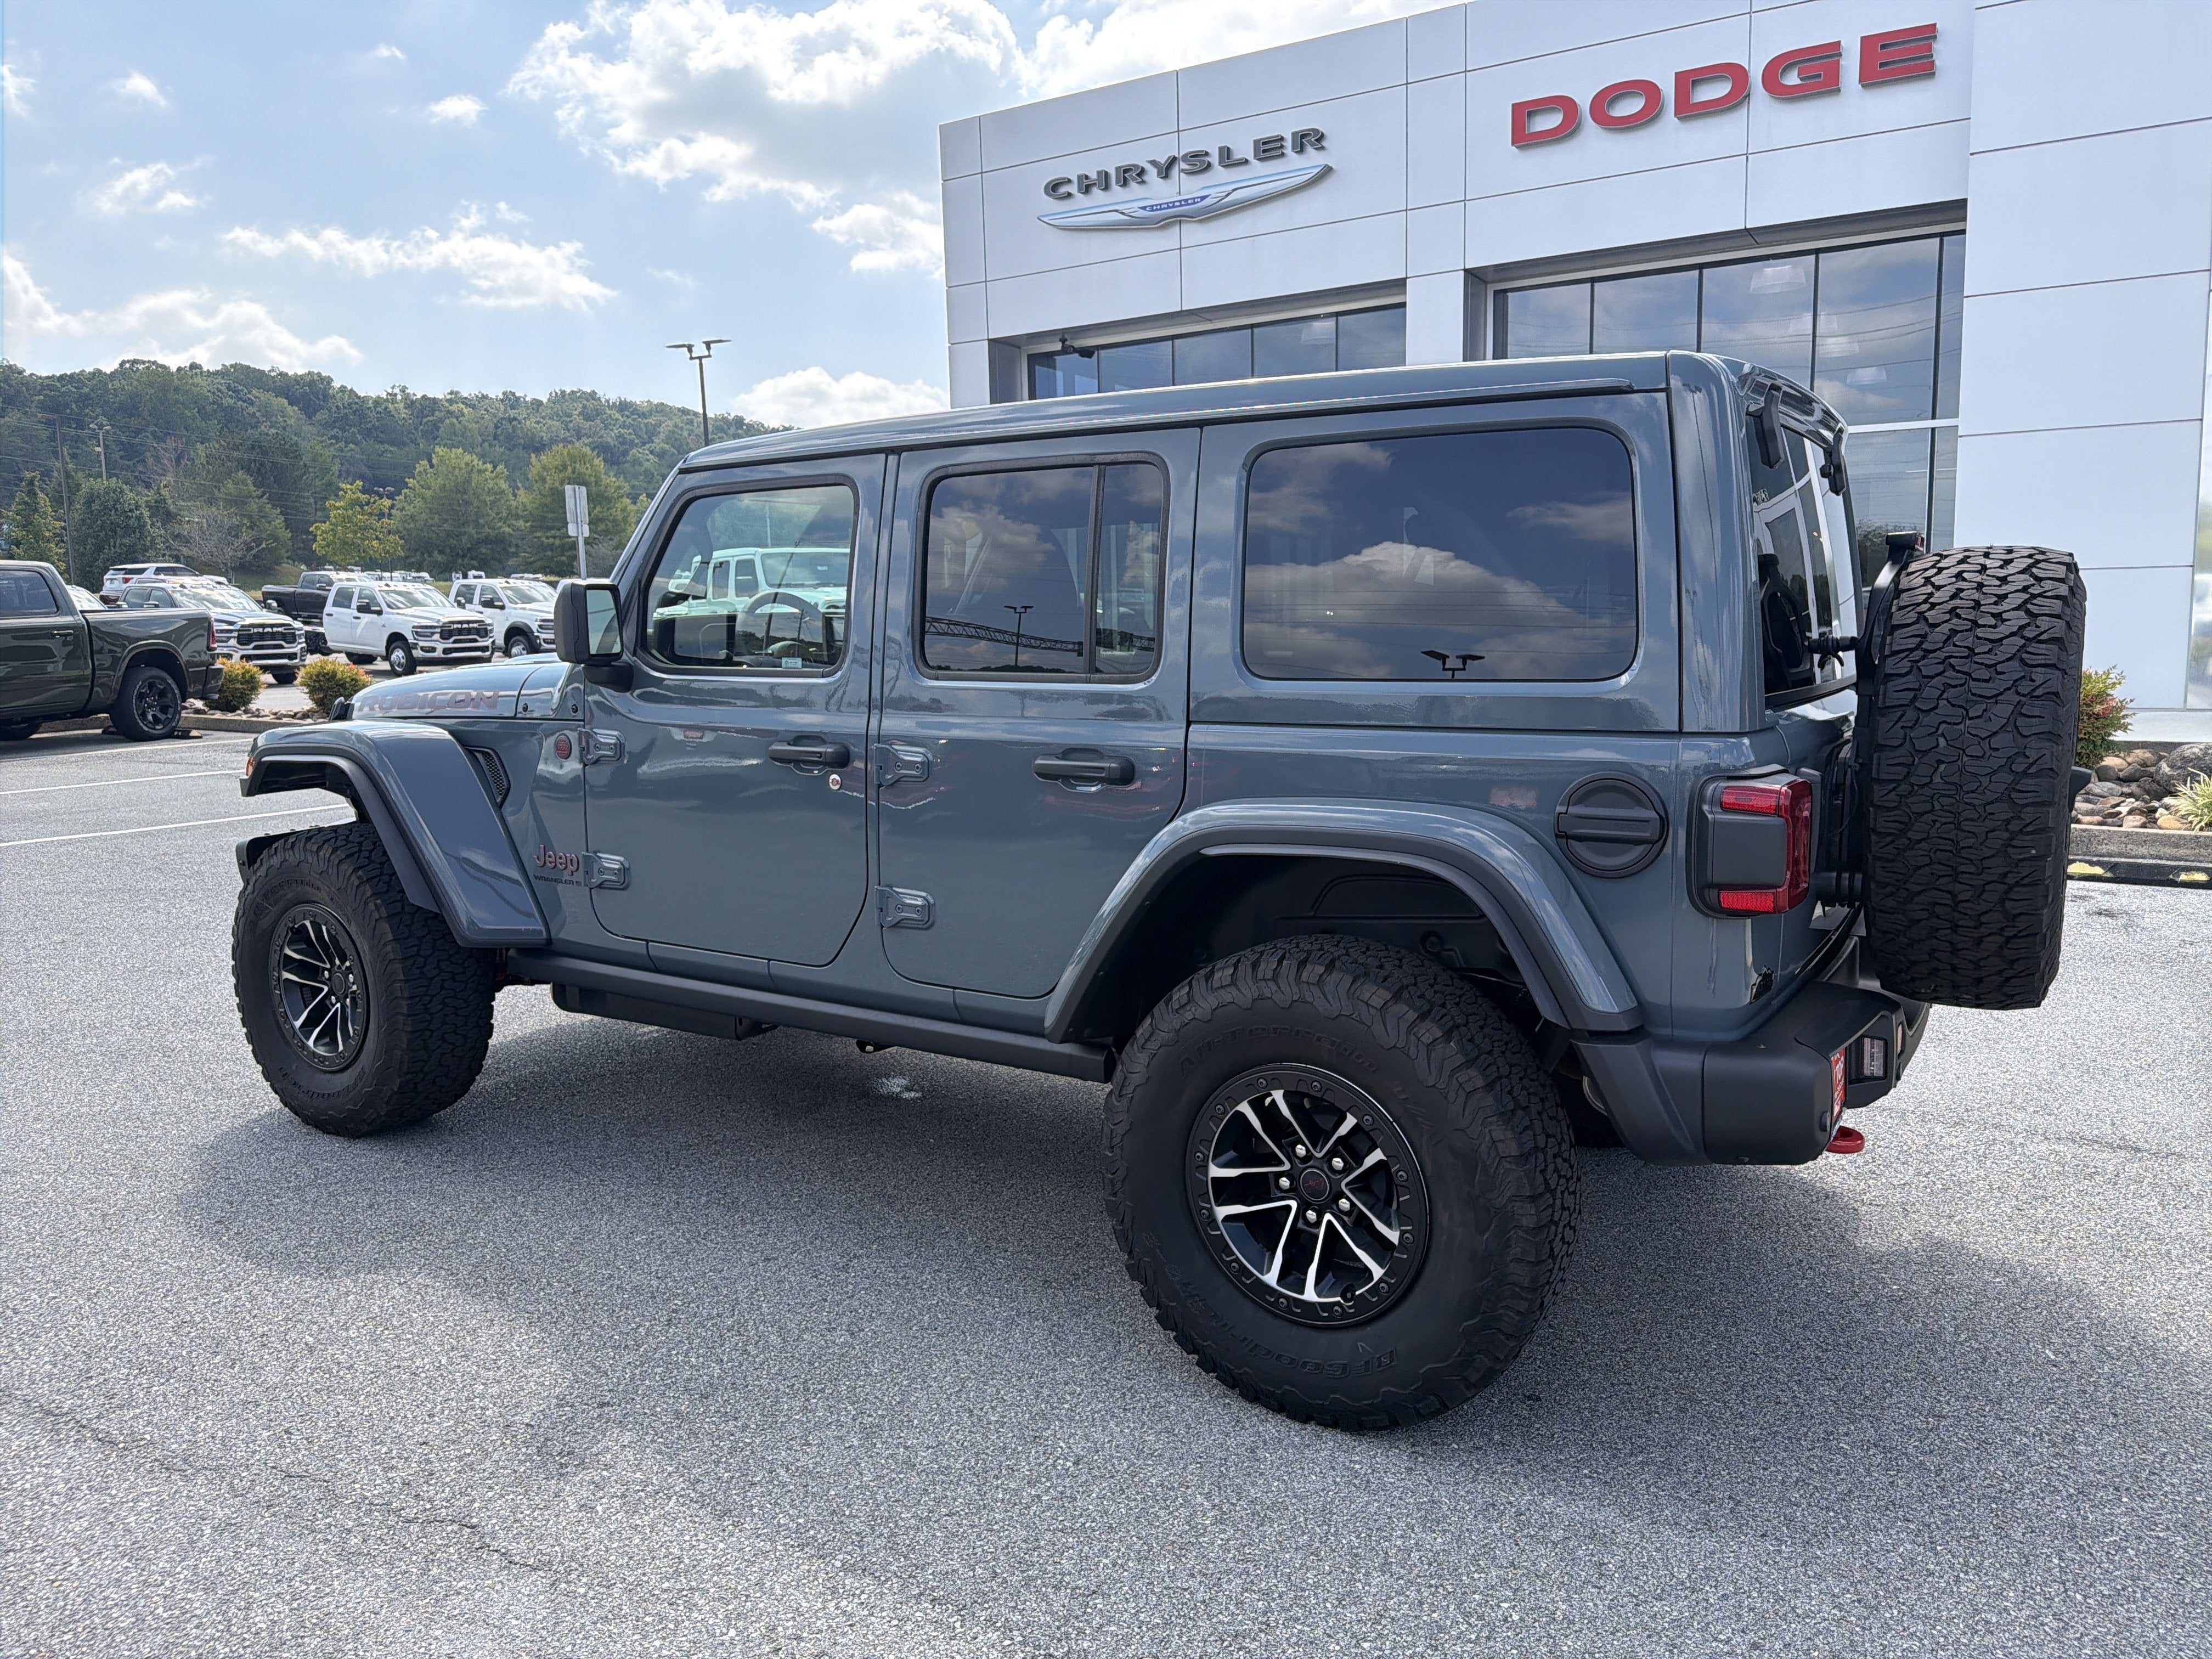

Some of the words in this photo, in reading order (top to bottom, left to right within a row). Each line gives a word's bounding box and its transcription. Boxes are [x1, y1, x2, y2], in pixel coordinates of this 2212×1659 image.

[1511, 22, 1938, 148] DODGE
[1043, 127, 1325, 199] CHRYSLER
[1146, 198, 1201, 211] CHRYSLER
[358, 691, 500, 712] RUBICON
[533, 844, 580, 876] Jeep
[533, 874, 574, 885] WRANGLER
